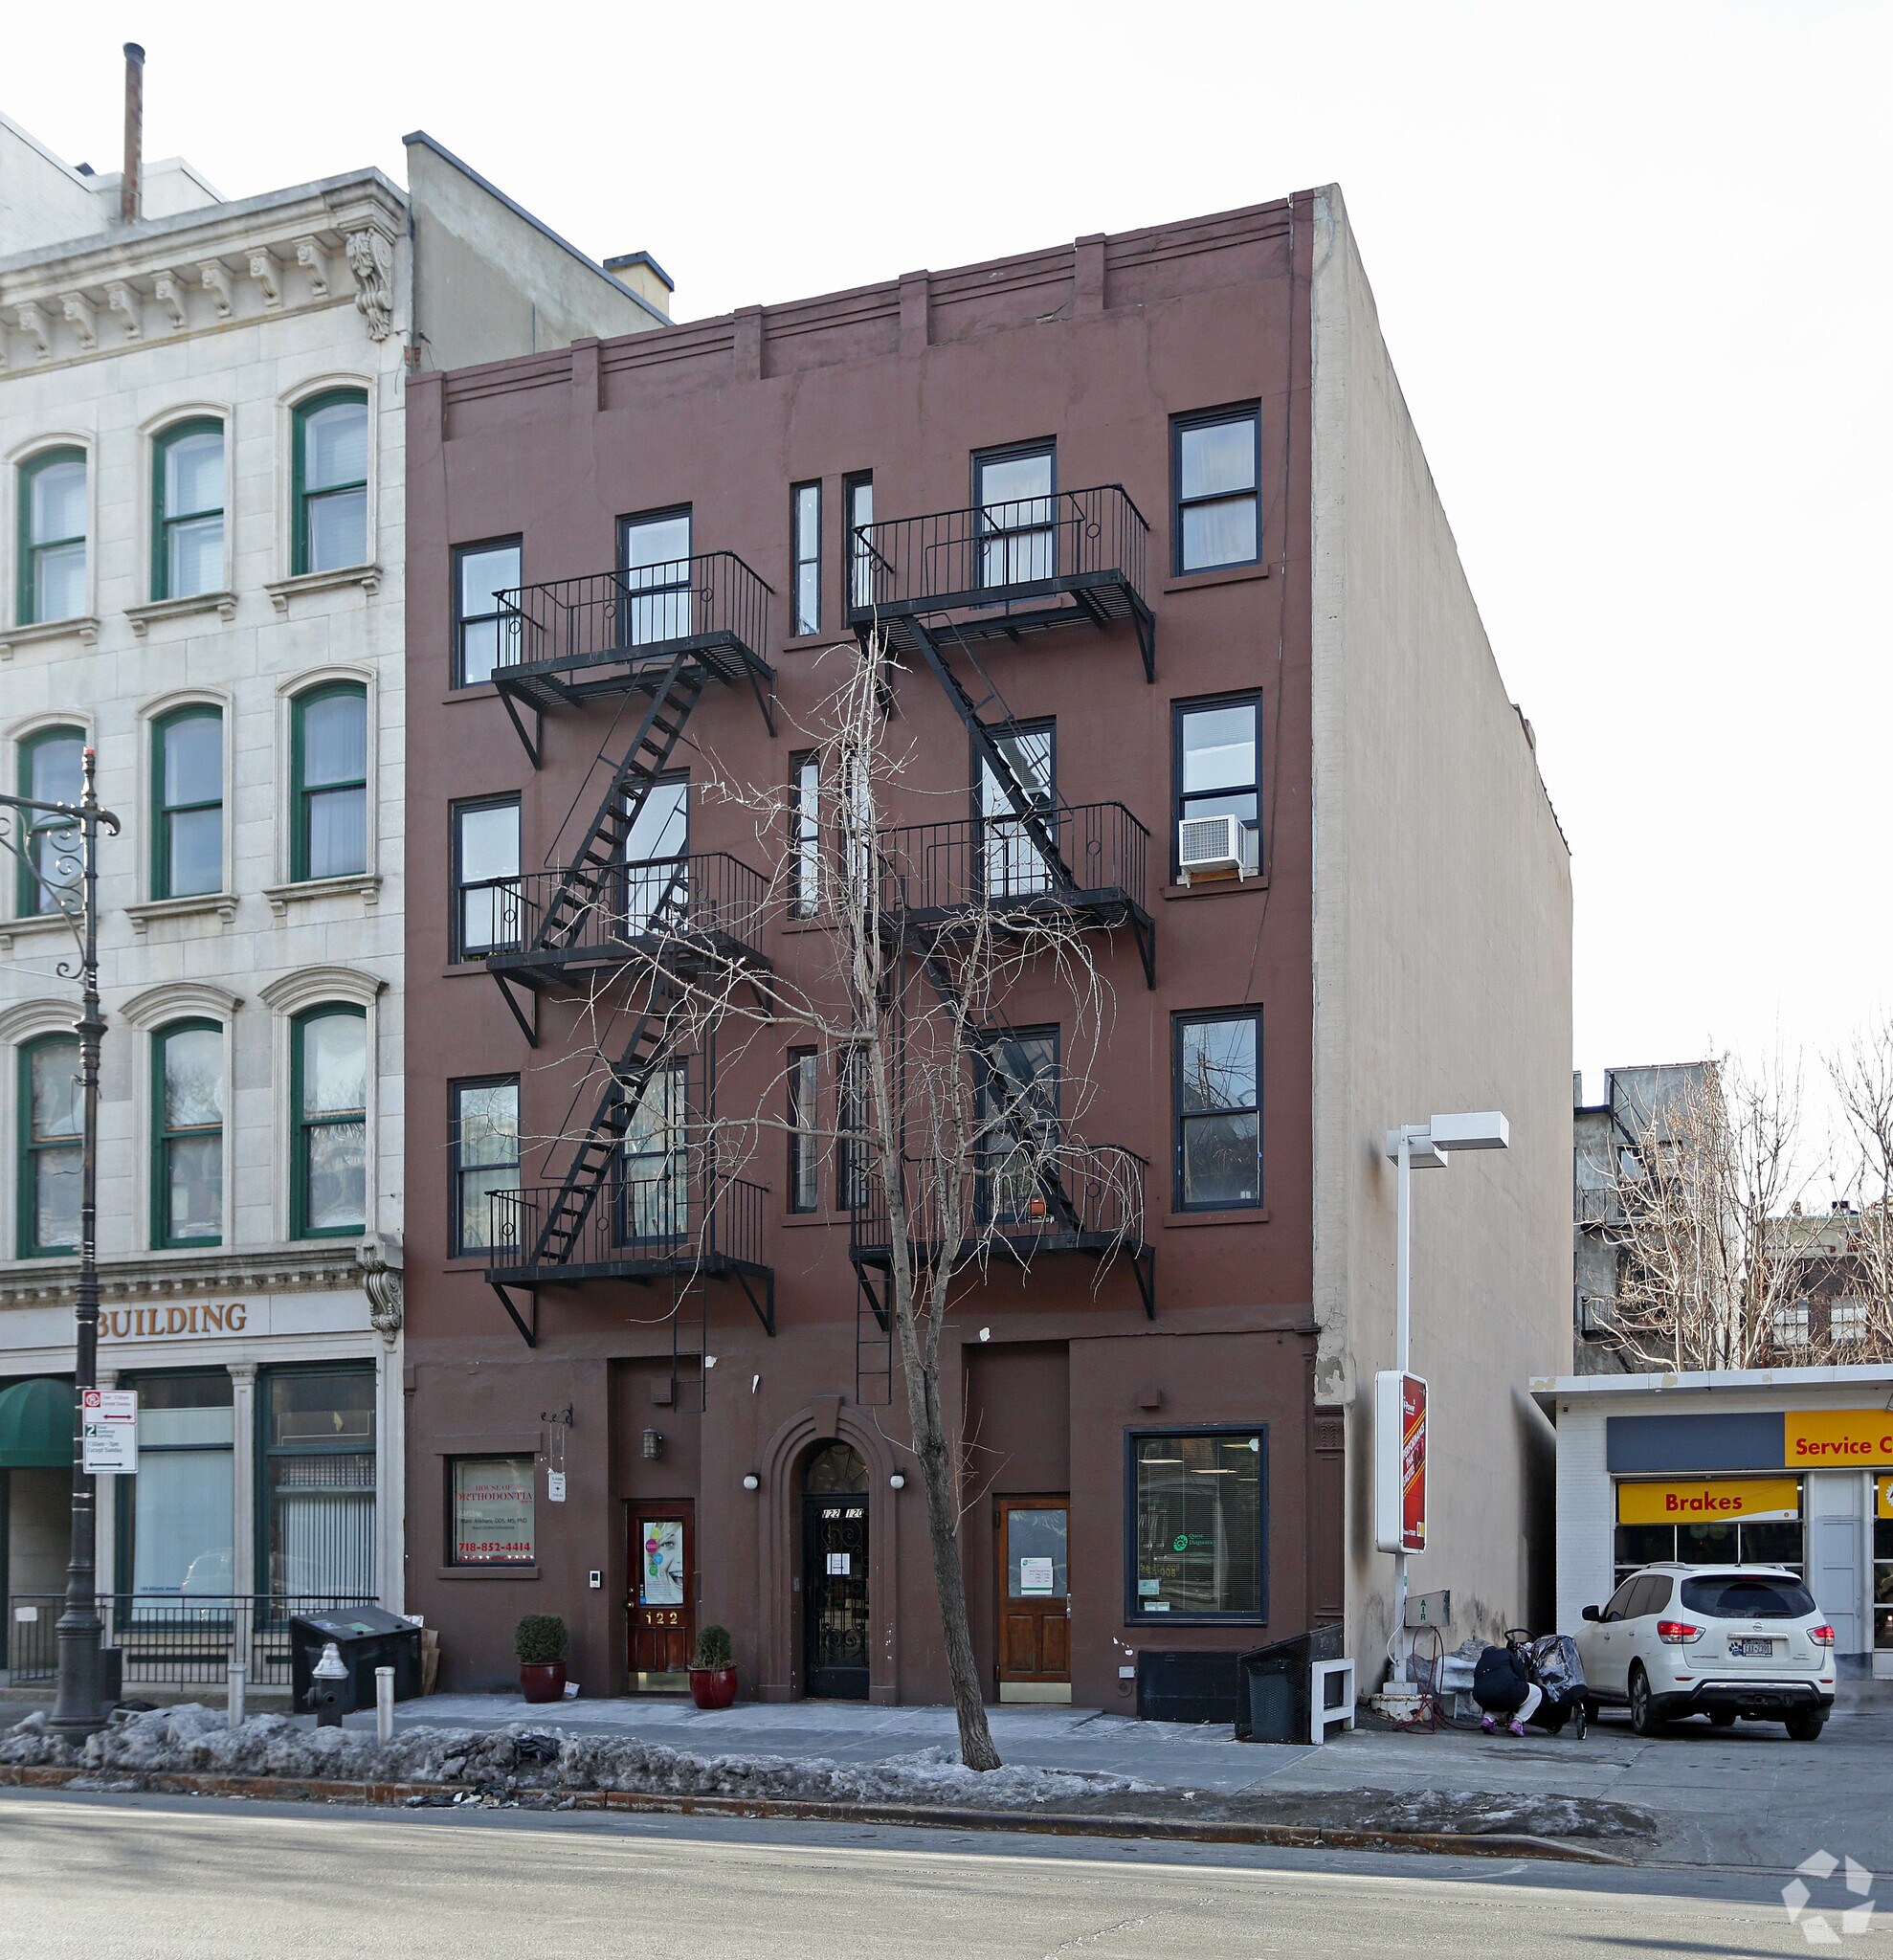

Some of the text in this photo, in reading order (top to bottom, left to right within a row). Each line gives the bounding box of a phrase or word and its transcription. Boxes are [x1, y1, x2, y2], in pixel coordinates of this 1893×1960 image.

[86, 1424, 96, 1437] 2
[1796, 1437, 1872, 1456] Service
[456, 1492, 533, 1502] ORTHODONTIA
[1666, 1491, 1743, 1511] Brakes
[823, 1508, 840, 1519] 122
[459, 1542, 531, 1551] 718-852-4414
[645, 1611, 679, 1625] 122
